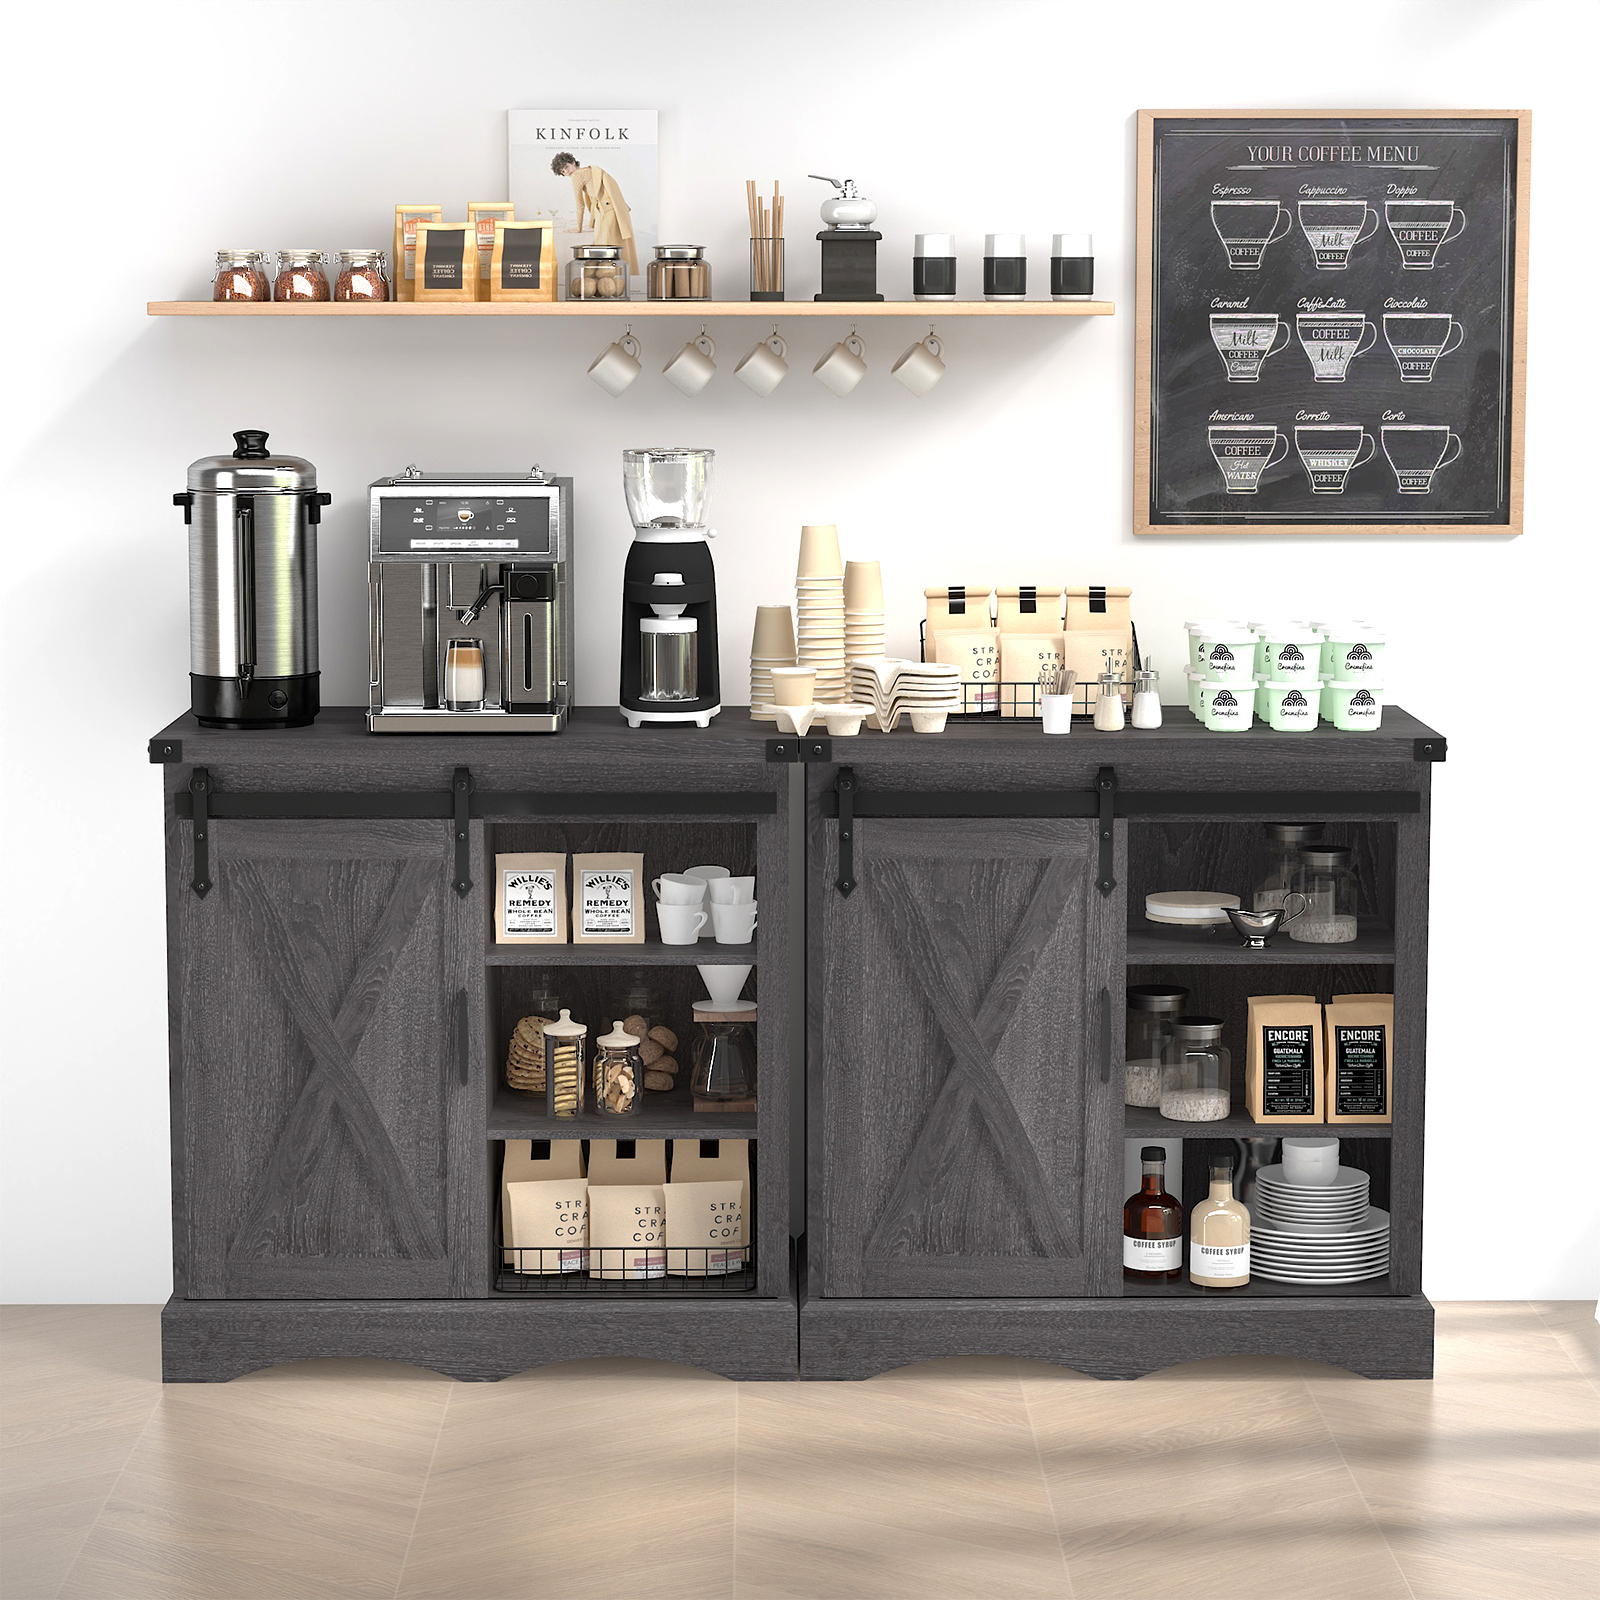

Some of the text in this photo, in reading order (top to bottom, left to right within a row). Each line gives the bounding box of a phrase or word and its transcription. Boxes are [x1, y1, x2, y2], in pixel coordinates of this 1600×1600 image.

[535, 127, 630, 141] KINFOLK
[1247, 145, 1420, 162] YOUR COFFEE MENU
[1212, 183, 1252, 197] Espresso
[1298, 183, 1348, 196] Cappuccino
[1385, 183, 1418, 196] Doppio
[1319, 232, 1345, 248] Milk
[1398, 229, 1439, 242] COFFEE
[1229, 247, 1261, 256] COFFEE
[1210, 296, 1249, 309] Caramel
[1383, 296, 1428, 309] Cioccolato
[1230, 330, 1259, 347] Milk
[1311, 328, 1351, 340] COFFEE
[1227, 349, 1259, 360] COFFEE
[1317, 346, 1346, 363] Milk
[1397, 347, 1437, 355] CHOCOLATE
[1401, 360, 1432, 371] COFFEE
[1208, 410, 1255, 422] Americano
[1294, 410, 1331, 422] Corretto
[1380, 410, 1406, 422] Corto
[1223, 445, 1262, 457] COFFEE
[1308, 458, 1350, 468] WHISKEY
[1226, 470, 1258, 481] WATER
[1313, 473, 1344, 484] COFFEE
[1400, 477, 1429, 486] COFFEE
[972, 646, 998, 656] STR
[1038, 652, 1065, 660] STR
[1101, 648, 1128, 657] STR
[507, 874, 553, 891] WILLIE'S
[585, 874, 630, 891] WILLIE'S
[509, 899, 551, 907] REMEDY
[586, 899, 629, 907] REMEDY
[1268, 1030, 1309, 1041] ENCORE
[1340, 1030, 1381, 1041] ENCORE
[555, 1199, 588, 1210] STR
[710, 1202, 741, 1212] STR
[634, 1206, 666, 1216] STR
[1133, 1239, 1177, 1249] COFFEE SYRUP
[1200, 1246, 1245, 1256] COFFEE SYRUP
